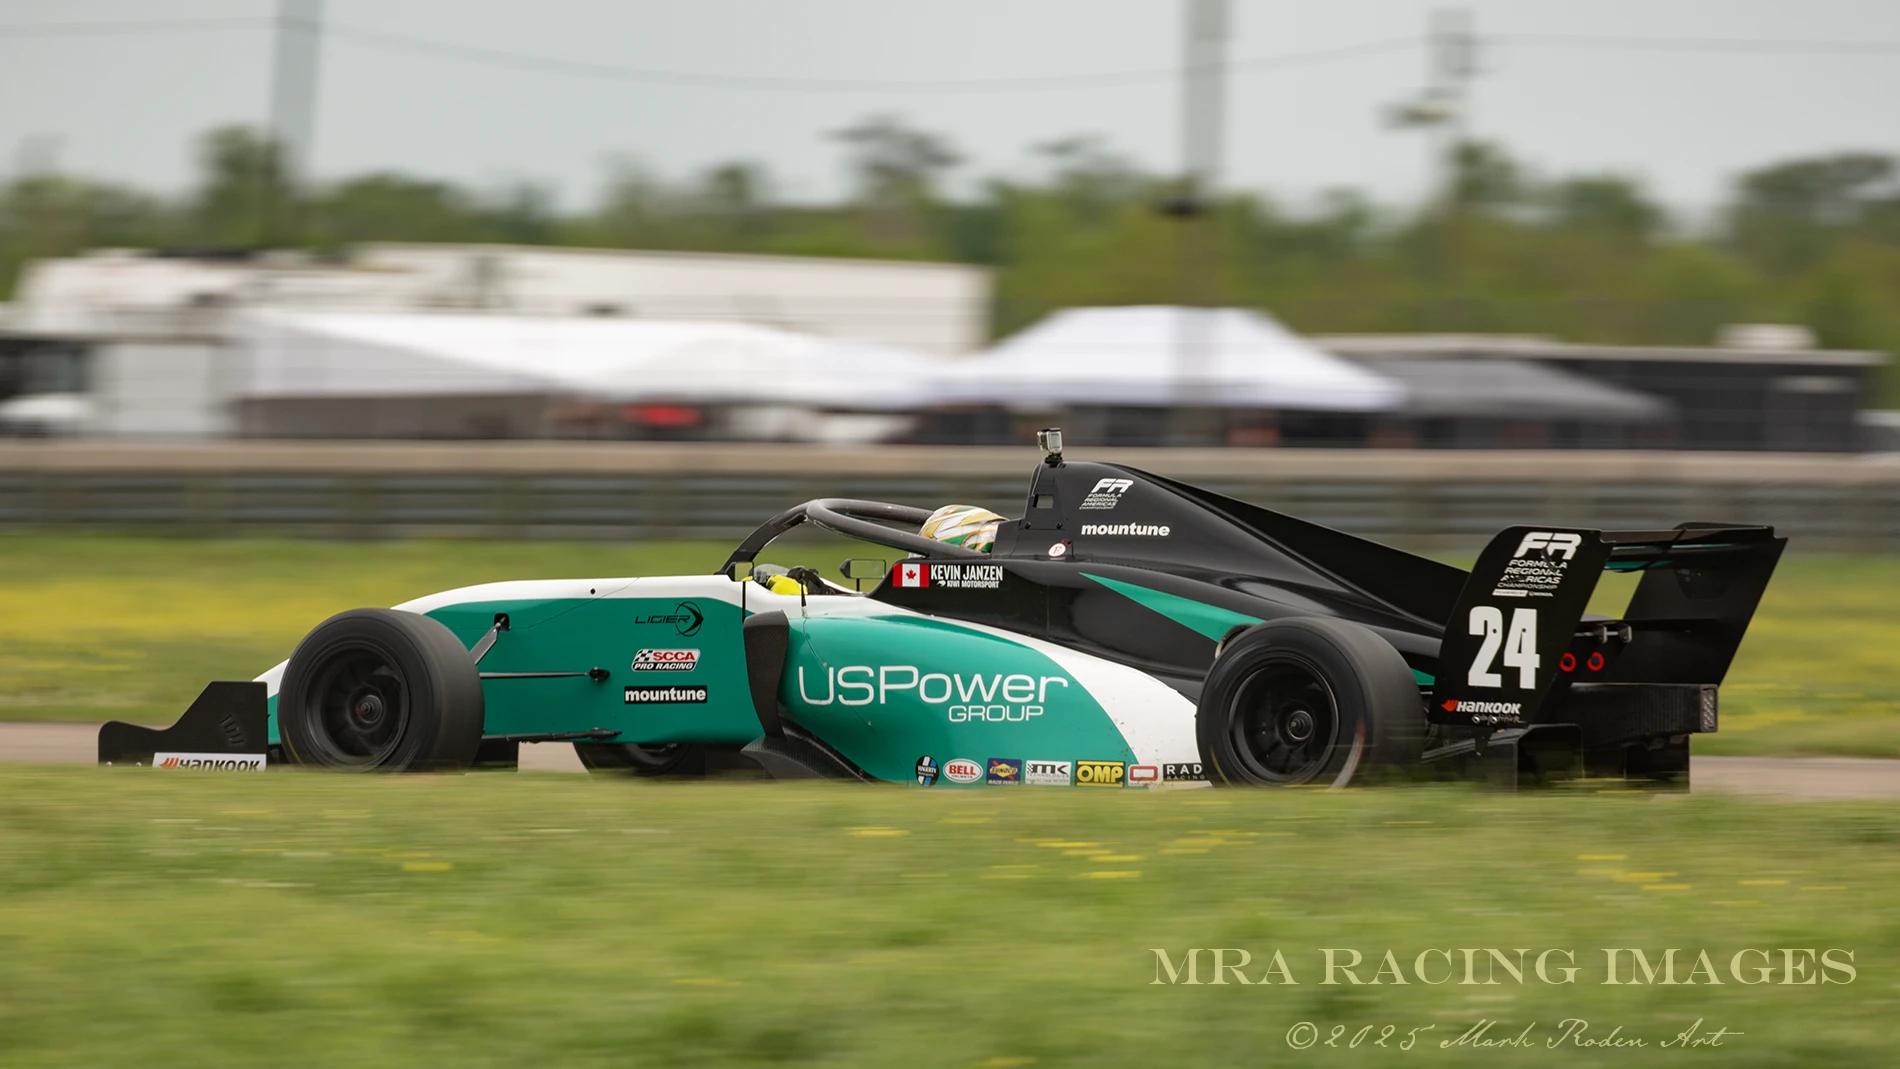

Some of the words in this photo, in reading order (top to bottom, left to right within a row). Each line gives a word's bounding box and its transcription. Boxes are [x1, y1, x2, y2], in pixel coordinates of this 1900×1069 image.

[1091, 478, 1134, 493] FR
[1081, 522, 1170, 536] mountune
[1513, 531, 1582, 560] FR
[931, 564, 961, 580] KEVIN
[962, 565, 1003, 581] JANZEN
[946, 580, 960, 588] KIWI
[961, 580, 999, 588] MOTORSPORT
[634, 615, 691, 624] LIGIER
[1468, 605, 1540, 689] 24
[653, 651, 695, 661] SCCA
[798, 665, 1069, 706] USPower
[625, 687, 706, 701] mountune
[948, 705, 1044, 723] GROUP
[948, 764, 976, 776] BELL
[1076, 765, 1124, 784] OMP
[1166, 764, 1204, 775] RAD
